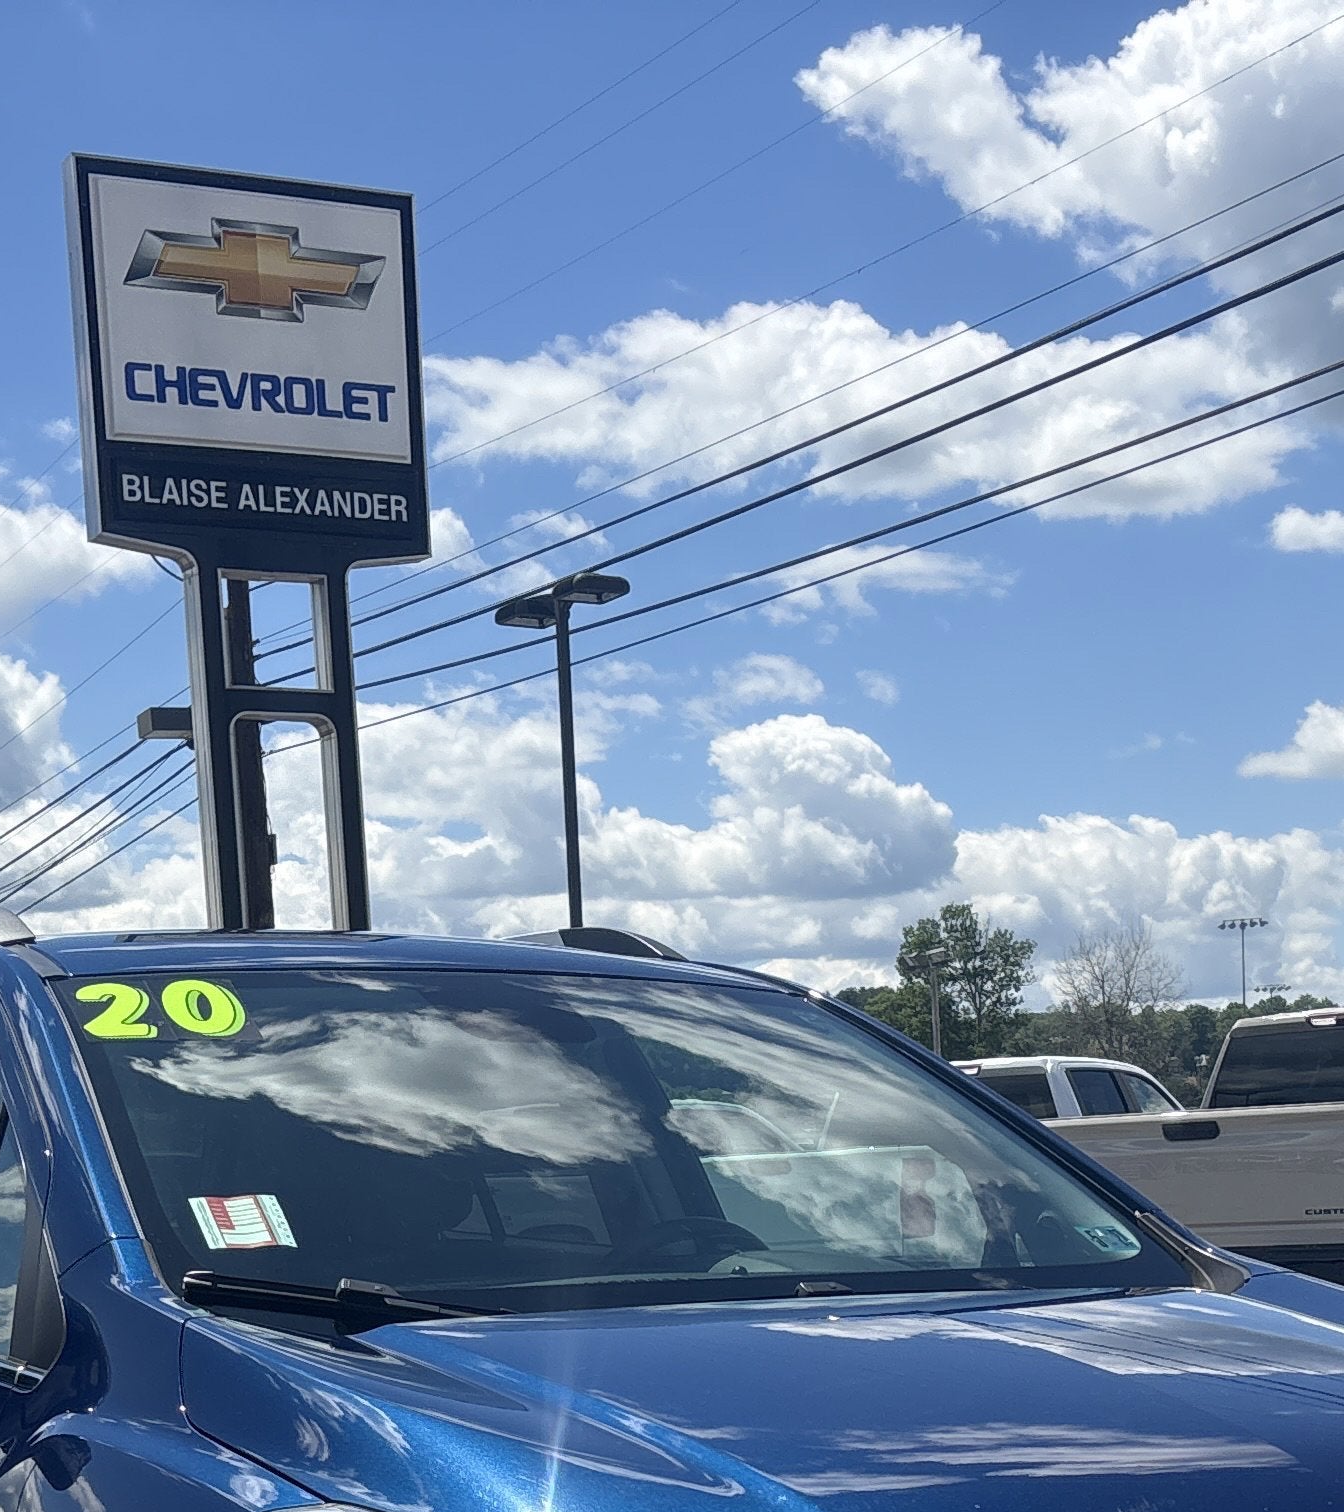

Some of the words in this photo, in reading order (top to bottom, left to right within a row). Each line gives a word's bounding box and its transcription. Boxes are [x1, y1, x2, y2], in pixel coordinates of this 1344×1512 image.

[124, 361, 396, 423] CHEVROLET
[121, 473, 229, 509] BLAISE
[238, 483, 408, 523] ALEXANDER
[75, 979, 247, 1039] 20
